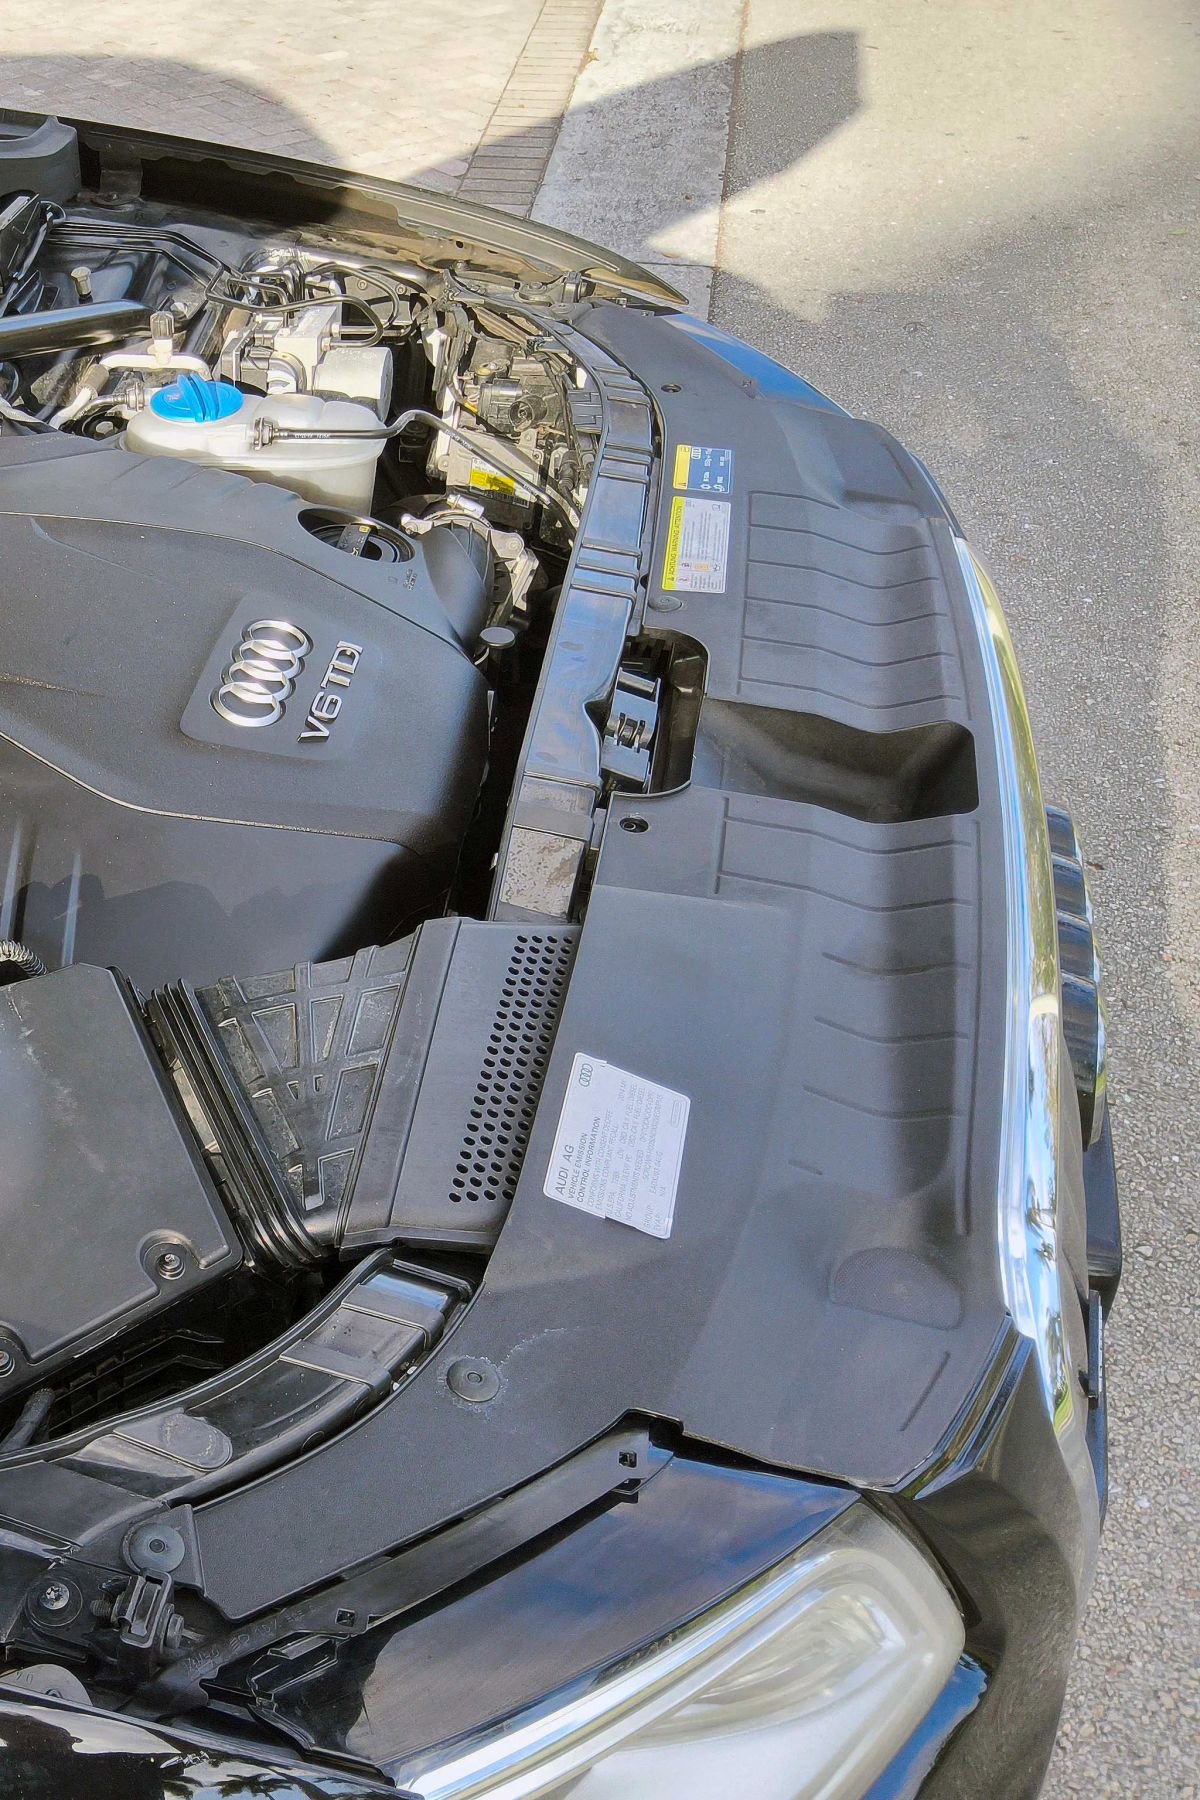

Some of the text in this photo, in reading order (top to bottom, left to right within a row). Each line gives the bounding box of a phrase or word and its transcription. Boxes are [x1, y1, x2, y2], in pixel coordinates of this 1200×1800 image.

[297, 640, 363, 743] V6 TDI
[555, 1144, 575, 1196] AUDI AG
[567, 1132, 588, 1199] VEHICLE EMISSION
[576, 1116, 601, 1203] CONTROL INFORMATION
